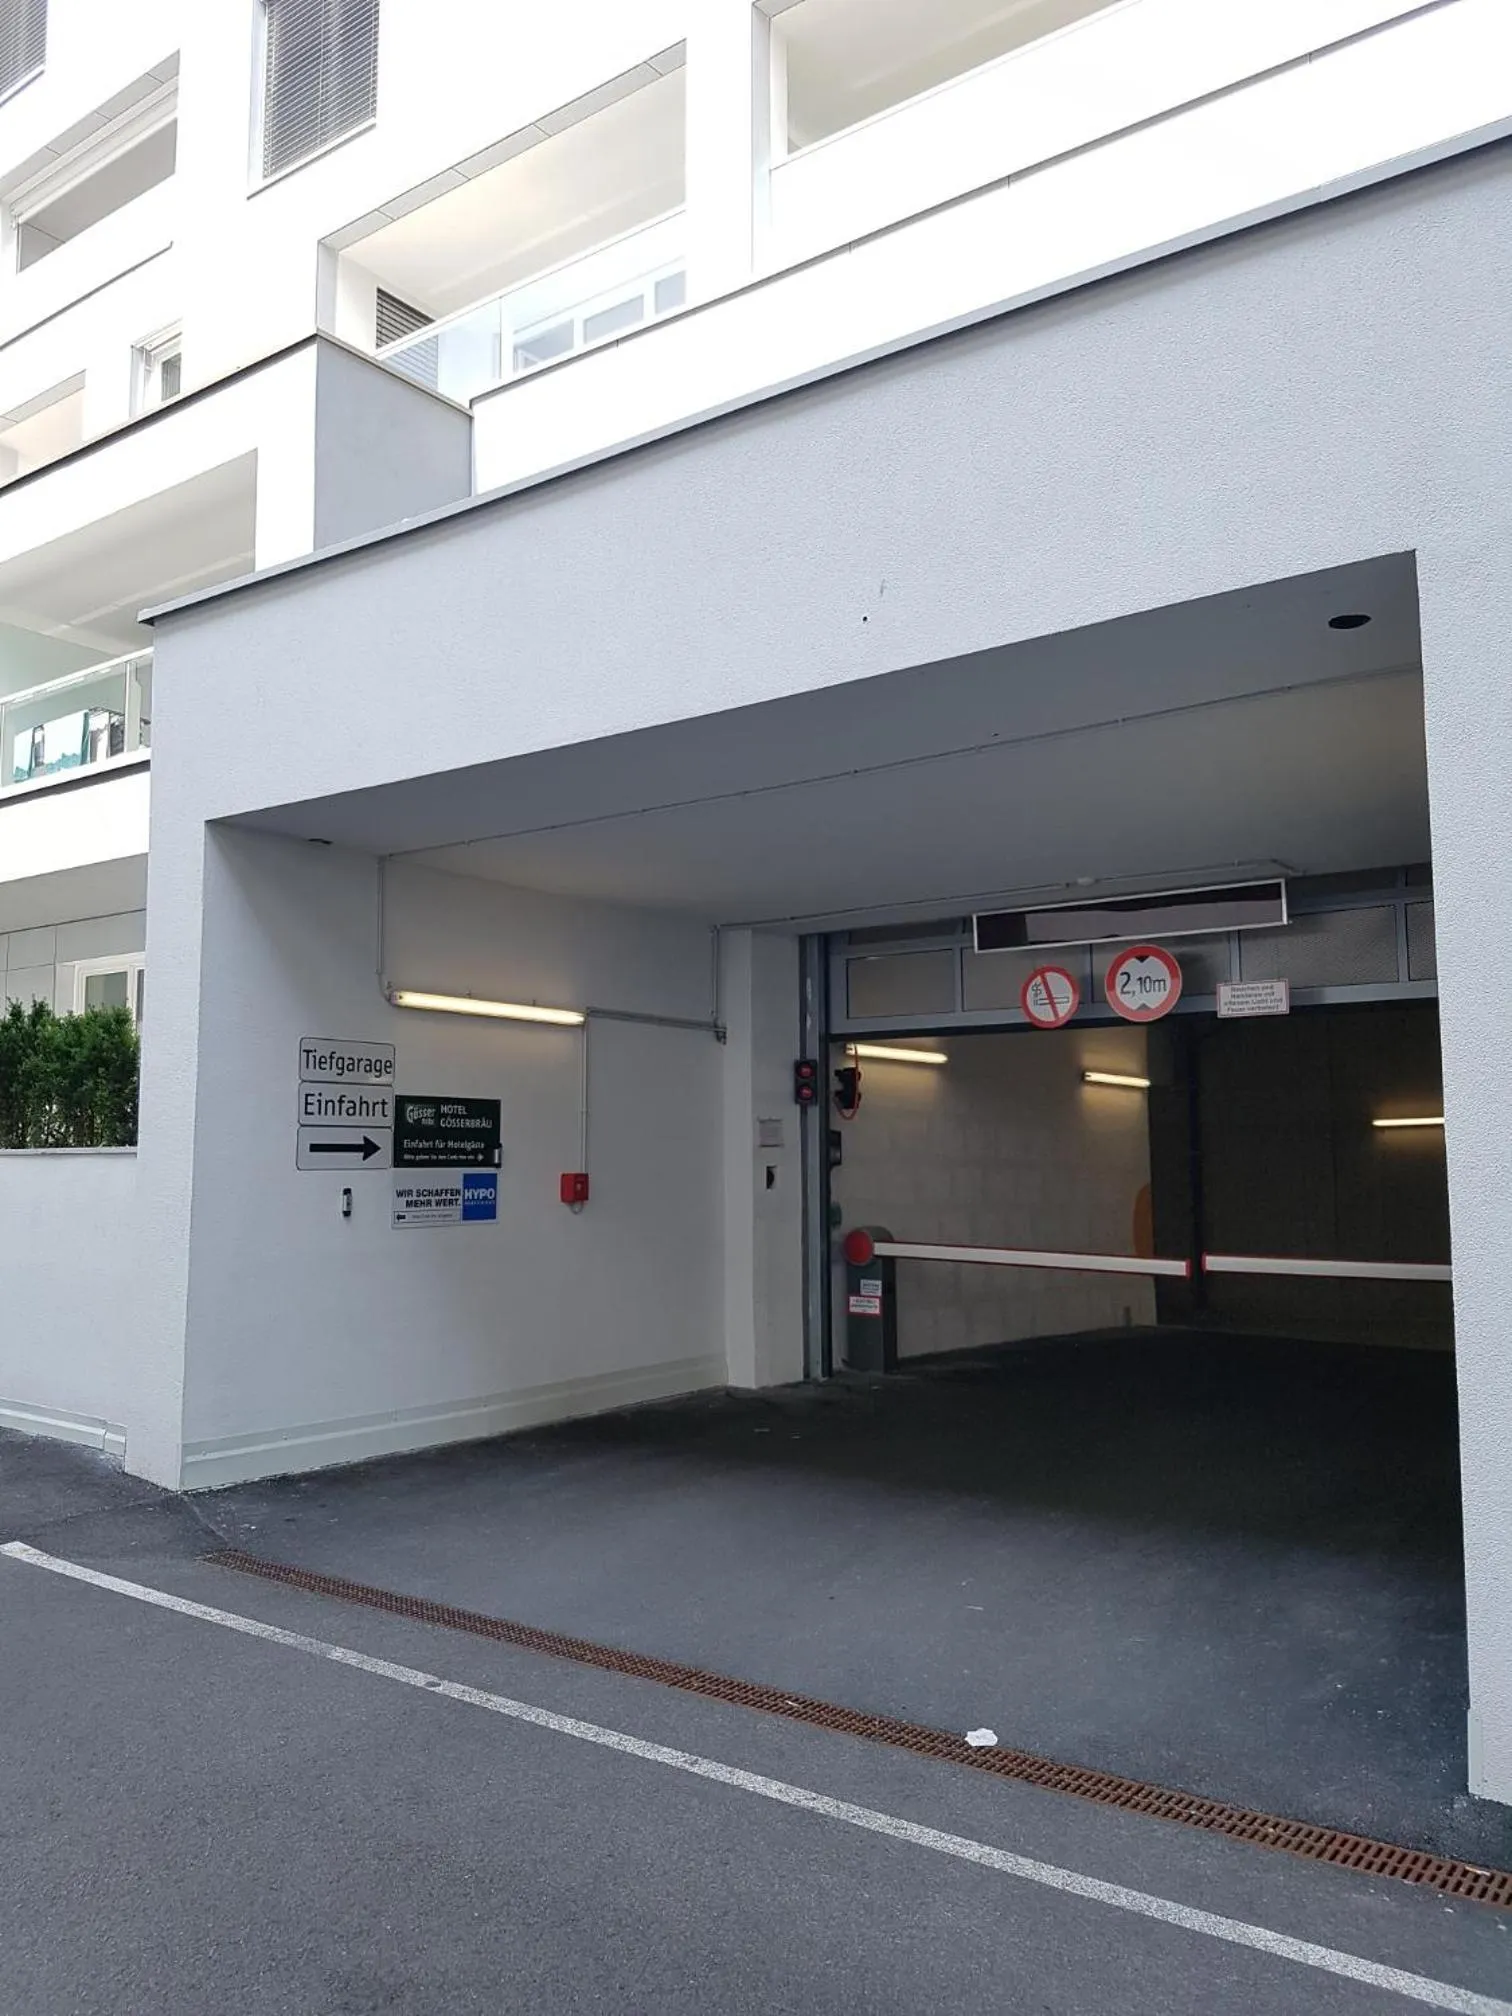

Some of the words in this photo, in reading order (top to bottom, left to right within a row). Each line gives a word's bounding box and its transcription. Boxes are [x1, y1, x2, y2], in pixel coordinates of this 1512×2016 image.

[1119, 971, 1167, 997] 2,10m
[302, 1048, 393, 1079] Tiefgarage
[304, 1092, 388, 1118] Einfahrt
[440, 1104, 467, 1115] HOTEL
[440, 1116, 493, 1129] GÖSSERBRÄU
[403, 1139, 434, 1149] Einfahrt
[435, 1139, 446, 1149] für
[395, 1189, 414, 1198] WIR
[416, 1187, 462, 1198] SCHAFFEN
[464, 1188, 496, 1200] HYPO
[405, 1199, 432, 1208] MEHR
[435, 1198, 461, 1208] WERT.
